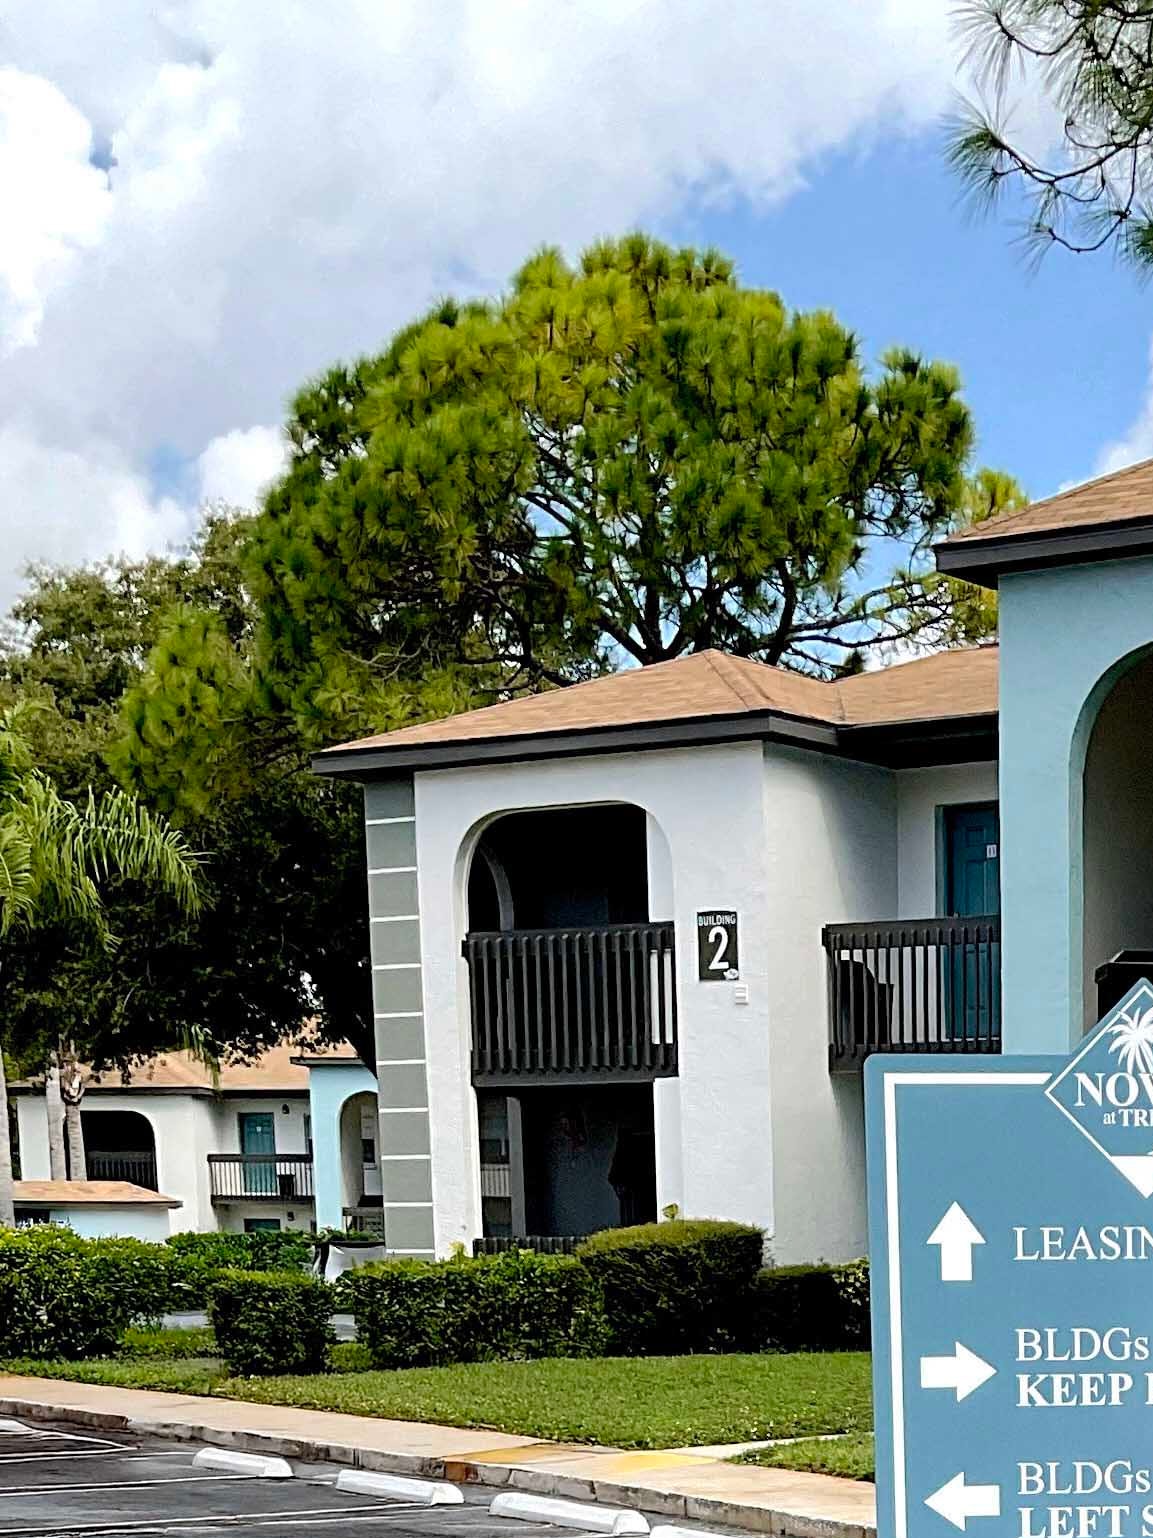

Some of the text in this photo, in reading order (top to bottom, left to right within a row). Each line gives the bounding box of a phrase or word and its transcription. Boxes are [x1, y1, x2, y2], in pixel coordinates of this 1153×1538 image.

[698, 914, 736, 926] BUILDING
[708, 926, 729, 970] 2
[1103, 1111, 1117, 1125] at
[1015, 1327, 1150, 1361] BLDGs
[1015, 1372, 1133, 1407] KEEP
[1017, 1460, 1151, 1495] BLDGs
